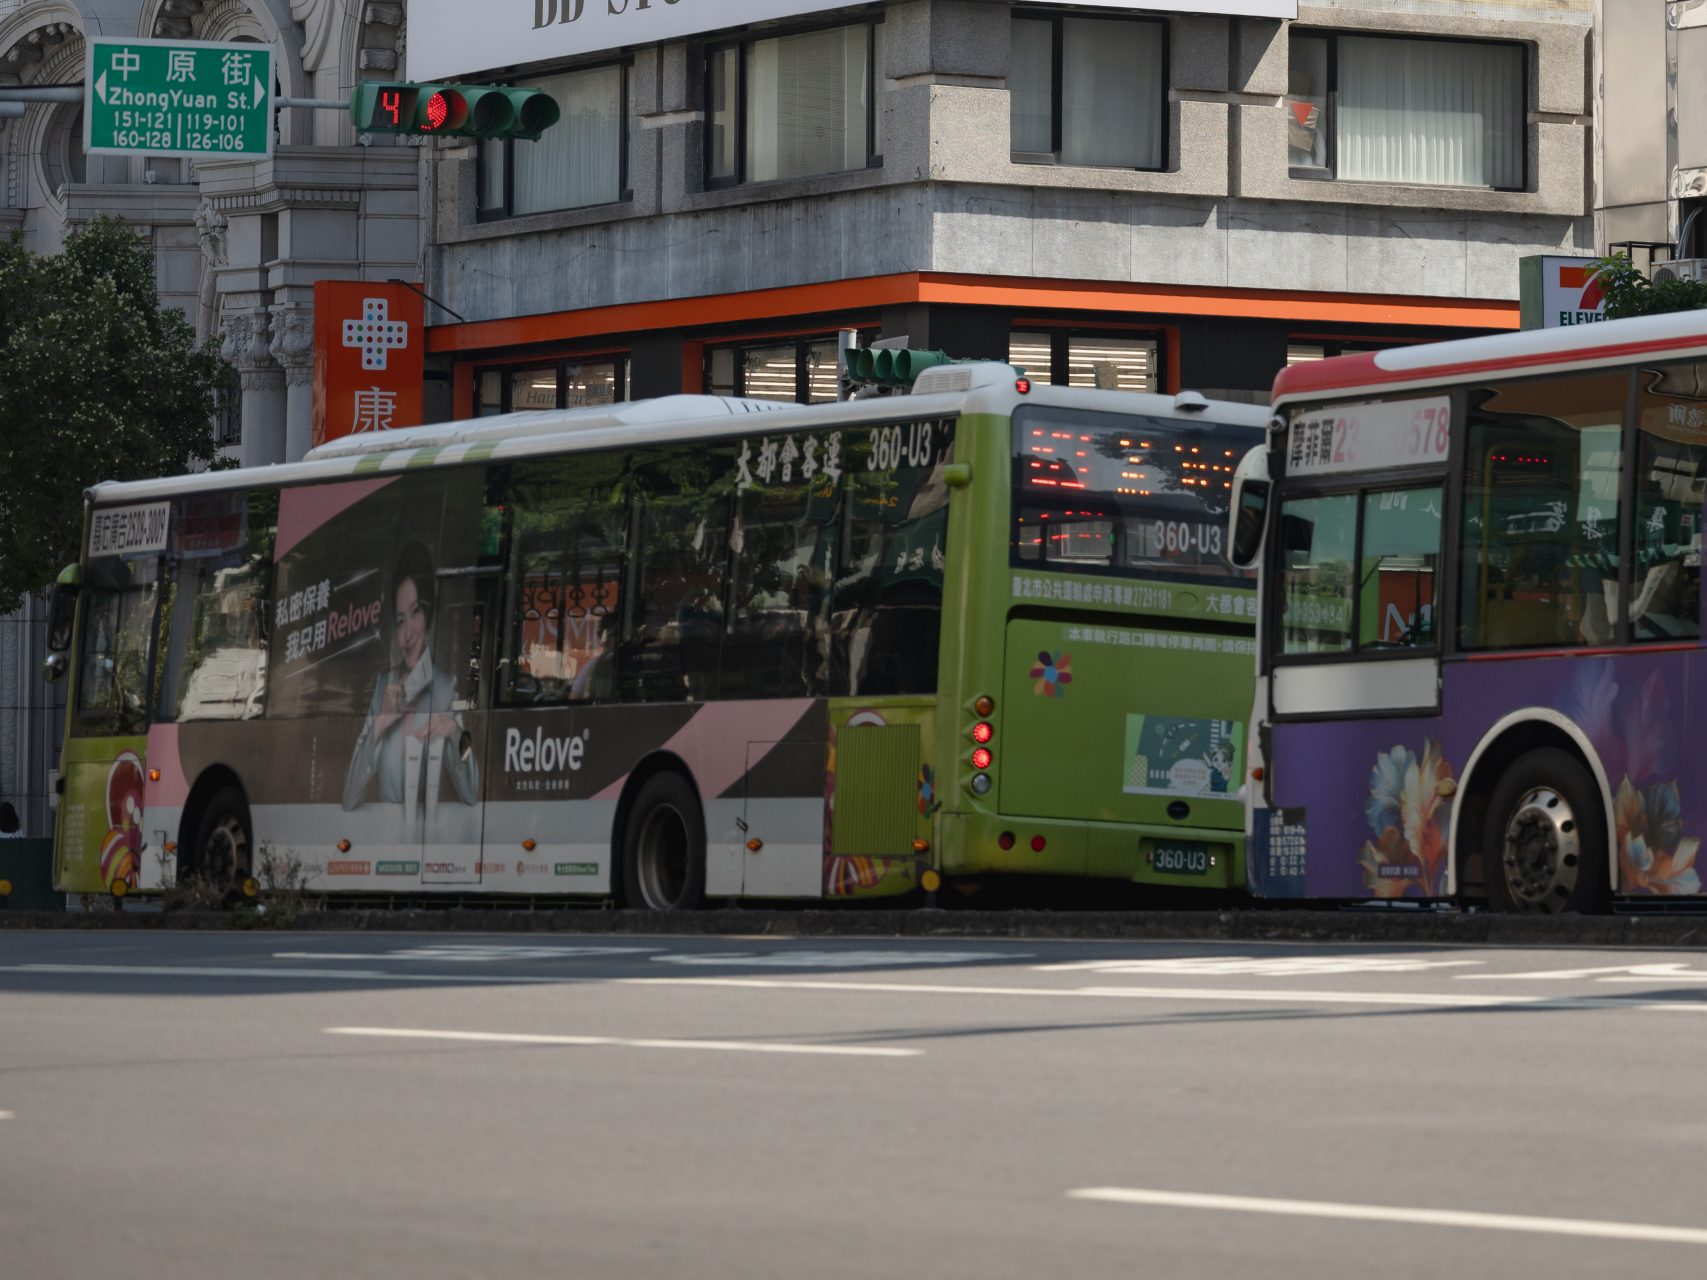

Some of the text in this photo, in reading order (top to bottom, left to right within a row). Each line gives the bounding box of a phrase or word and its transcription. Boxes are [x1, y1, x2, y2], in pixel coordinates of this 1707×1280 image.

[111, 48, 252, 86] 中原街
[108, 86, 251, 112] ZhongYuan St.
[383, 92, 400, 124] 4
[114, 111, 245, 131] 151-121 119-101
[112, 130, 245, 150] 160-128 126-106
[351, 385, 397, 434] 康
[735, 422, 932, 486] 大都會客運 360-U3
[1153, 520, 1220, 555] 360-U3
[275, 578, 330, 629] 私密保養
[504, 725, 584, 772] Relove
[1156, 849, 1205, 870] 360-U3
